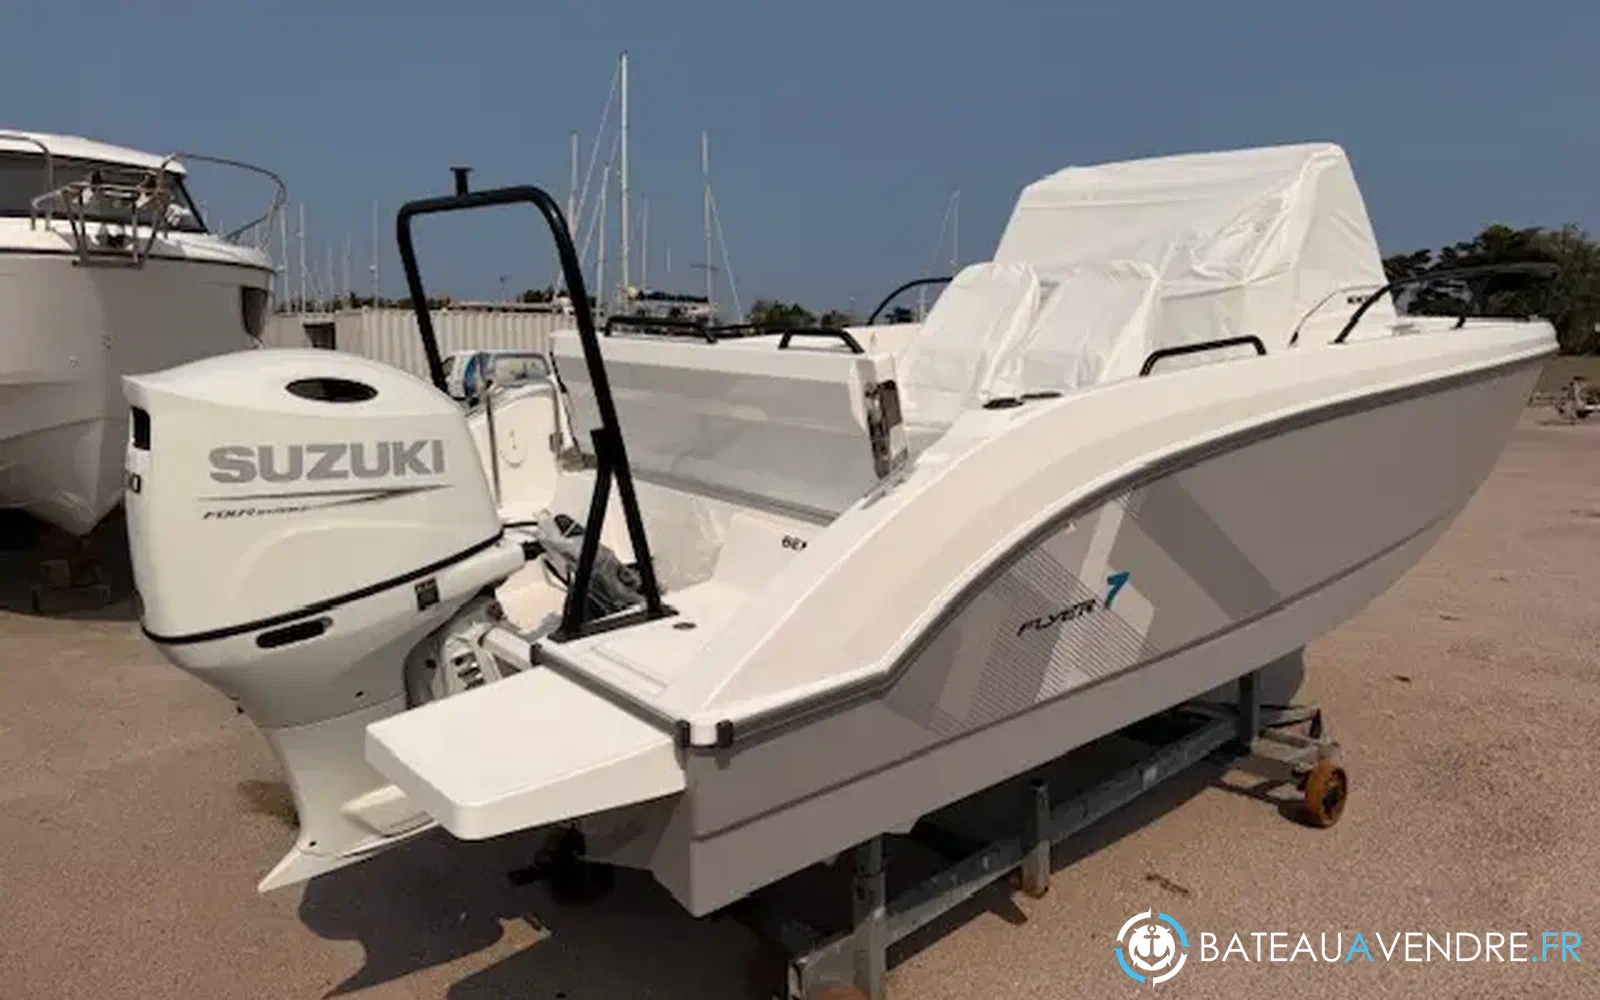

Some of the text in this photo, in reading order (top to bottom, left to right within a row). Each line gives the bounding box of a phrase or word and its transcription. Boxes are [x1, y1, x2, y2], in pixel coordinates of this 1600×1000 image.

[208, 439, 447, 484] SUZUKI
[1016, 571, 1131, 637] FLYER 7
